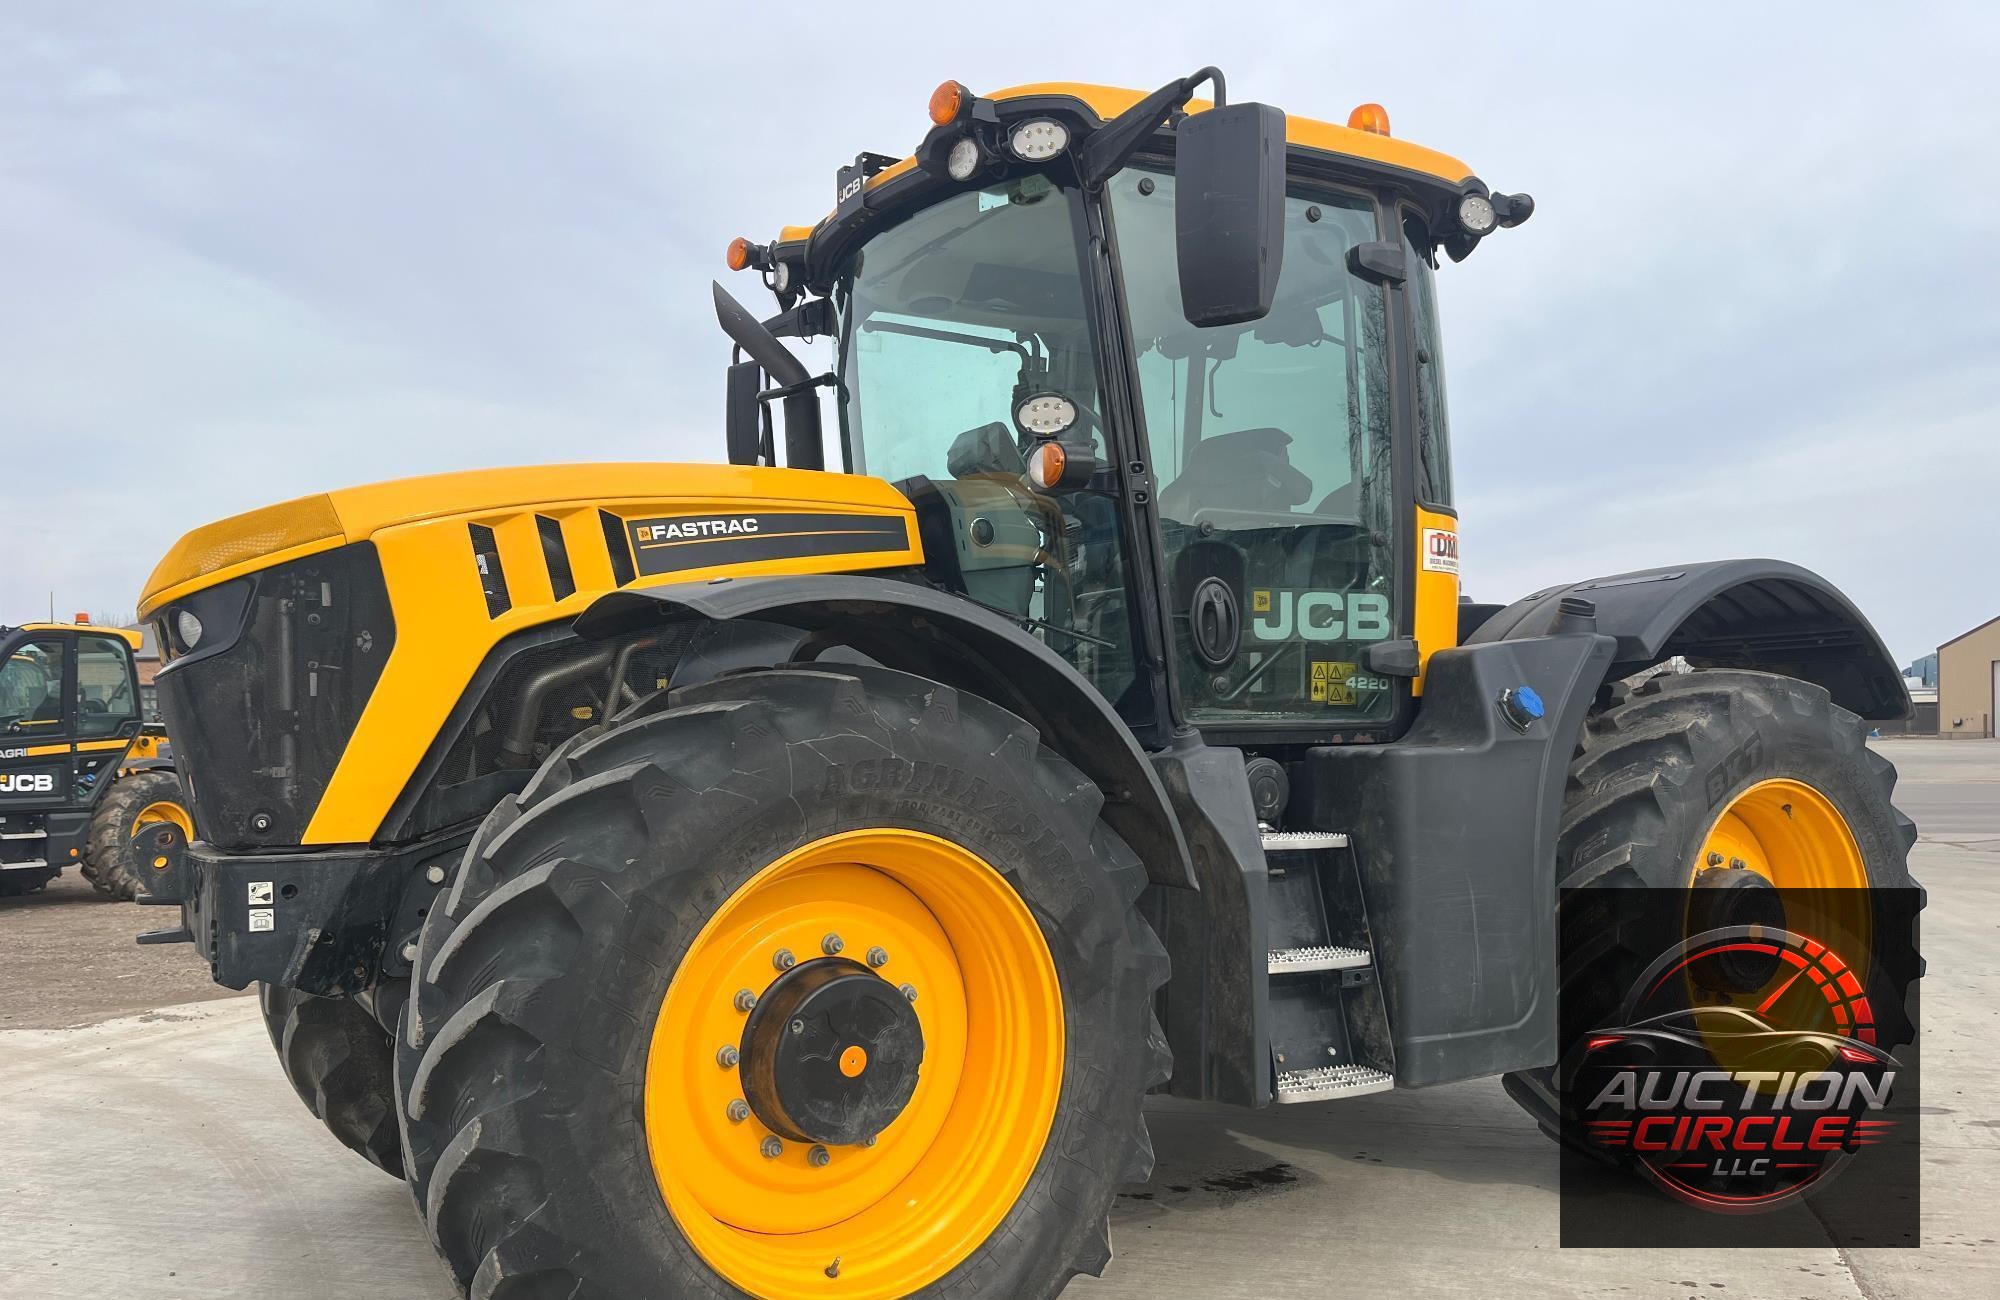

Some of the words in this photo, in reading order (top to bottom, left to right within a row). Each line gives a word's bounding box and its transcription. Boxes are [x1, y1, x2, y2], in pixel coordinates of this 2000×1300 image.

[838, 177, 861, 204] JCB
[650, 517, 759, 541] FASTRAC
[1253, 591, 1390, 640] JCB
[1345, 676, 1389, 690] 4220
[0, 747, 27, 759] AGRI
[0, 774, 53, 792] JCB
[901, 799, 927, 812] FOR
[930, 804, 962, 821] FAST
